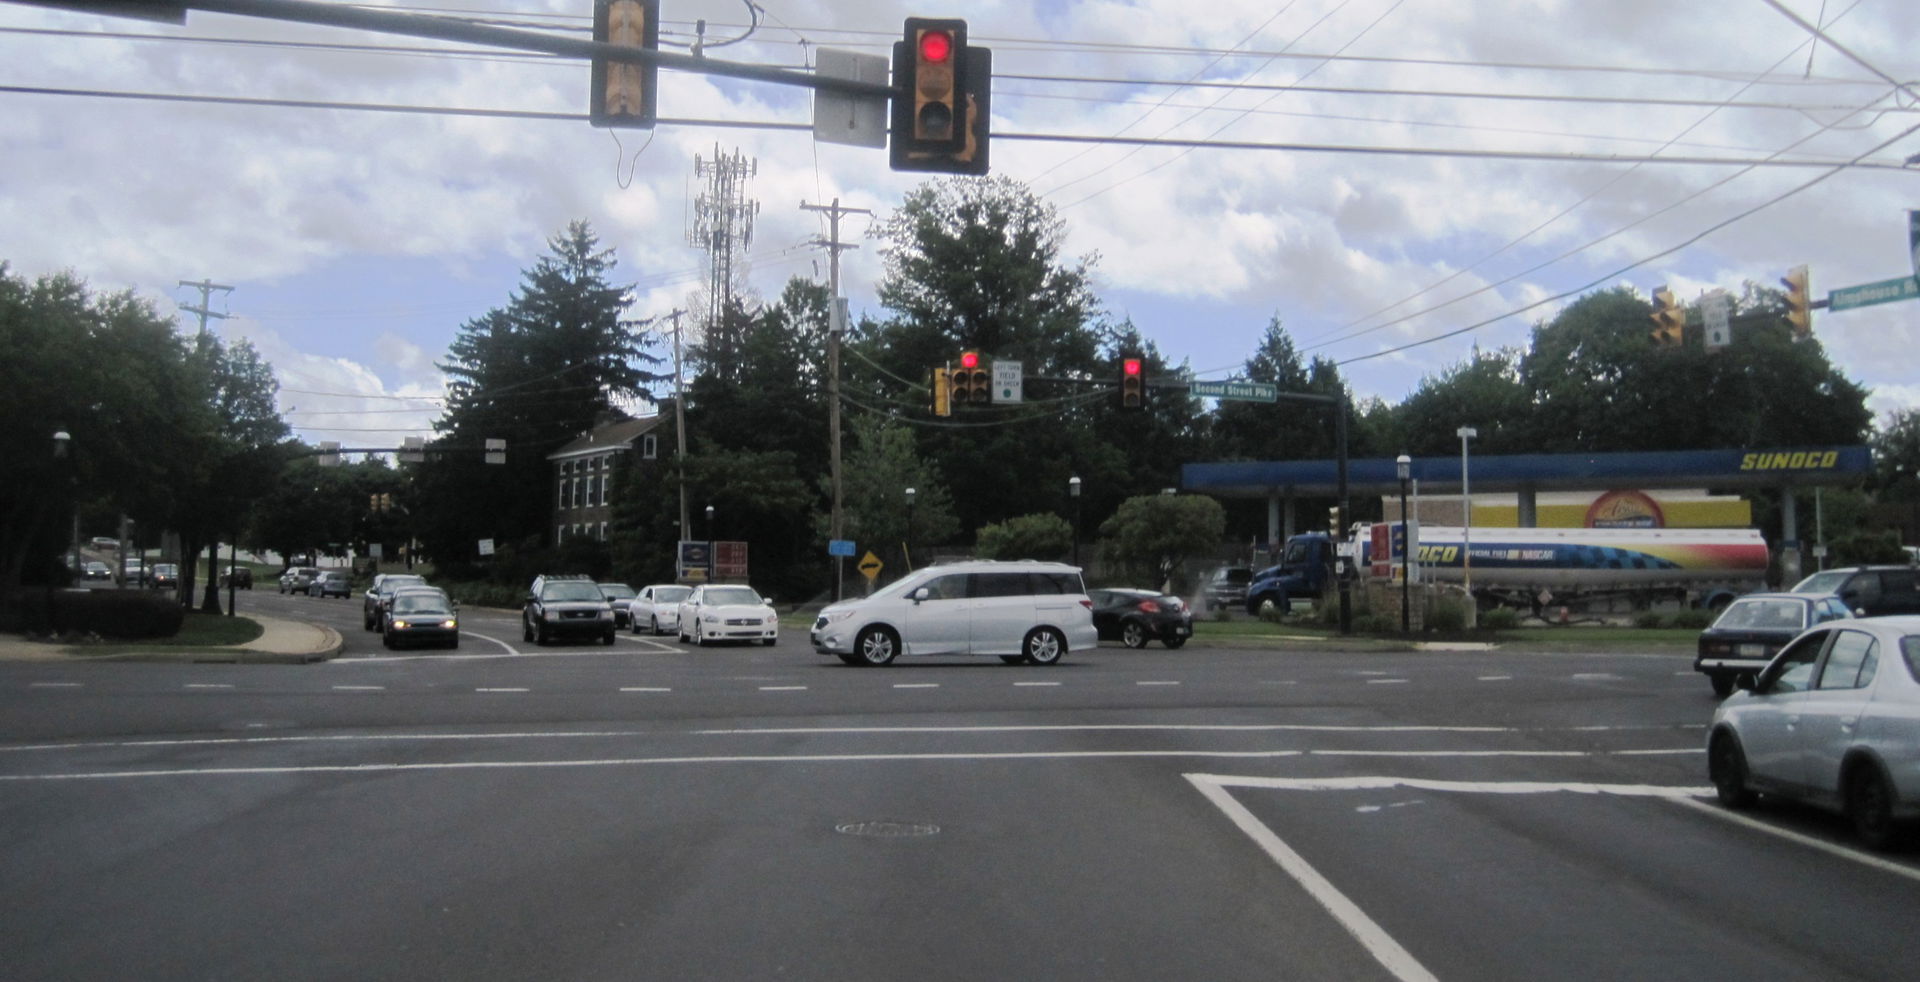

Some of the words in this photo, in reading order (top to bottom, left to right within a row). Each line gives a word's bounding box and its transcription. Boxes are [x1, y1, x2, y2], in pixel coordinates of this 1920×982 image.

[1195, 383, 1225, 394] Second
[1227, 384, 1252, 397] Street
[1255, 386, 1273, 398] Pike
[1740, 450, 1838, 470] SUNOCO
[1522, 549, 1553, 560] NASCAR
